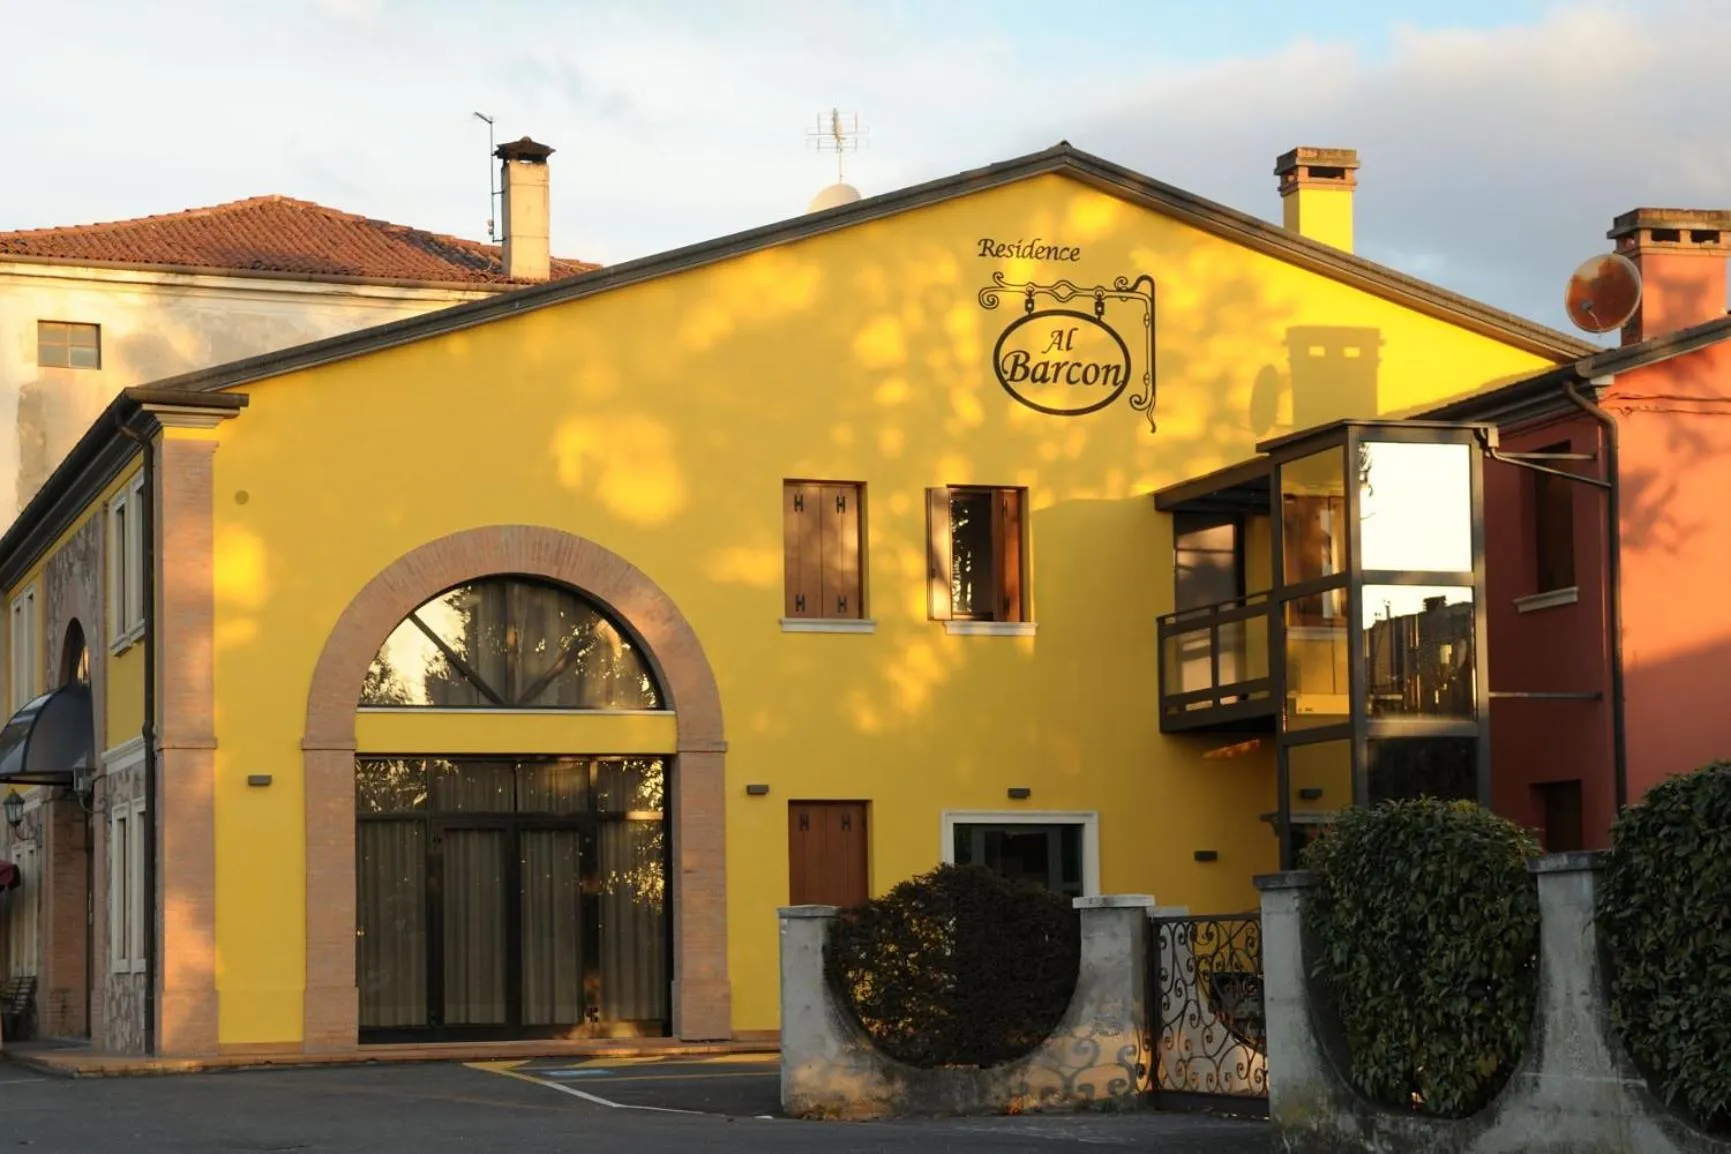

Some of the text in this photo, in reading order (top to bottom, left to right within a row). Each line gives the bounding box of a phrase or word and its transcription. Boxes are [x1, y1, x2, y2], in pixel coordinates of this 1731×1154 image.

[977, 238, 1081, 261] Residence
[1041, 328, 1079, 353] Al
[1001, 350, 1123, 387] Barcon
